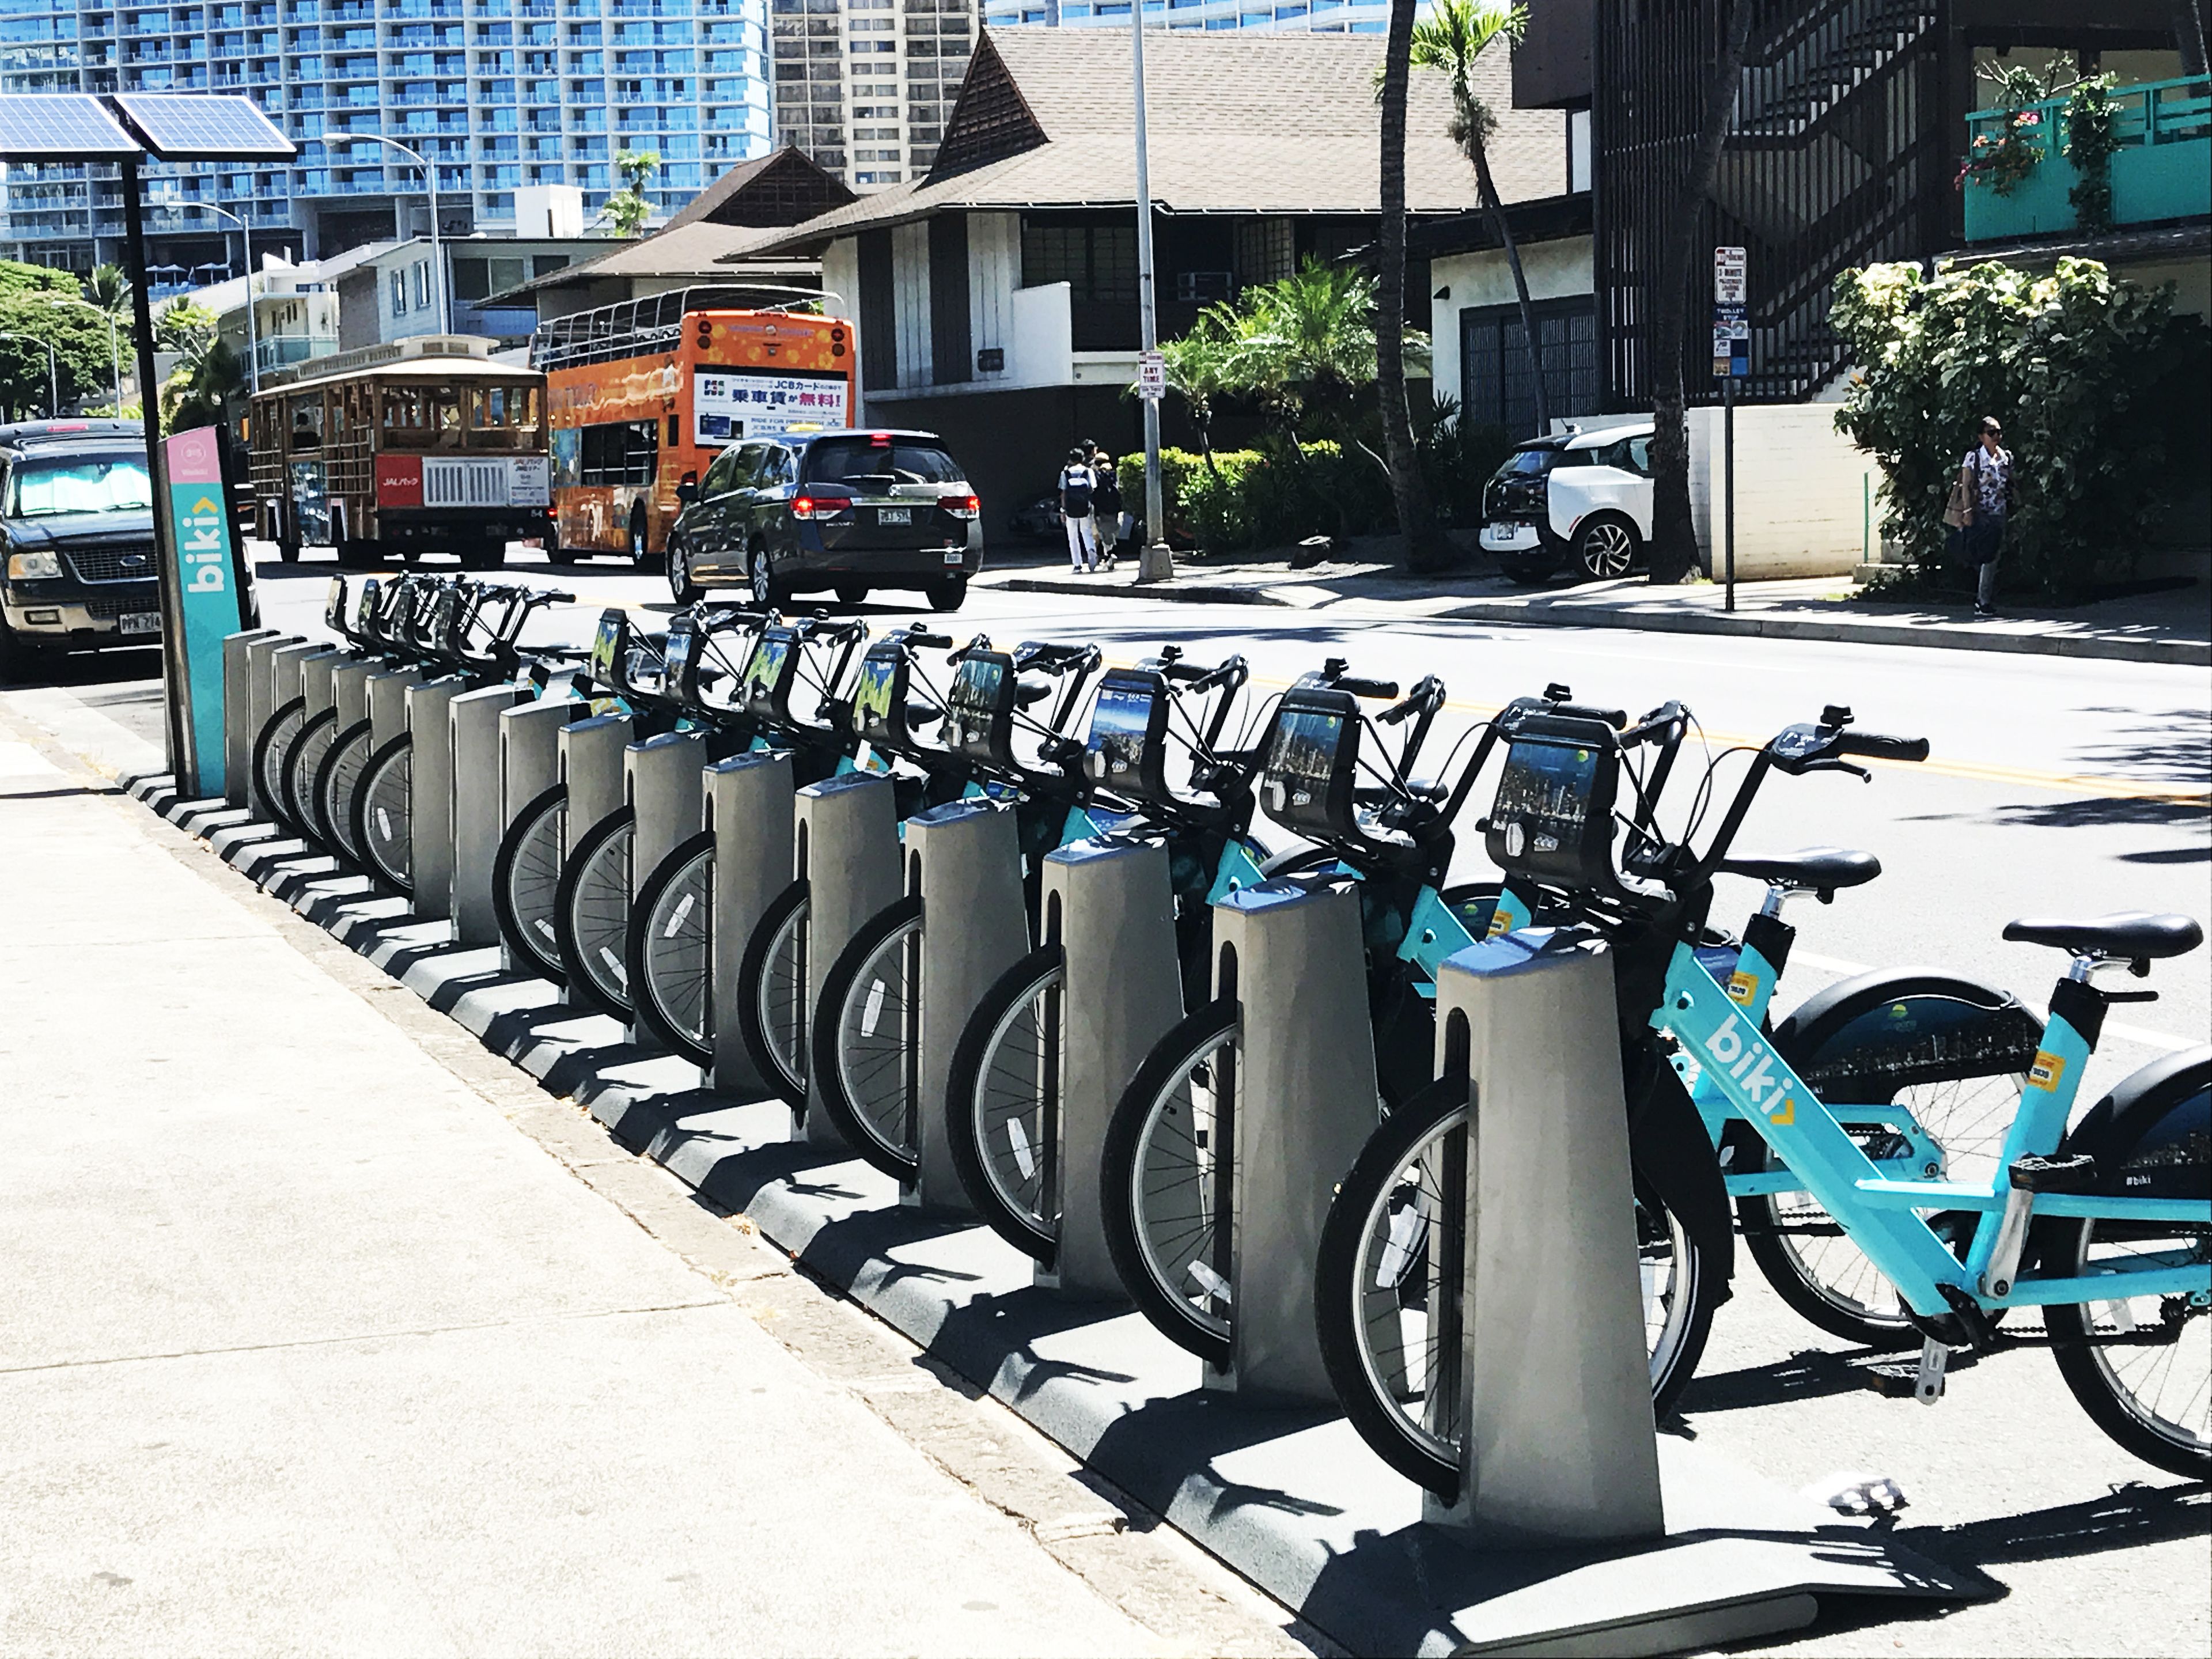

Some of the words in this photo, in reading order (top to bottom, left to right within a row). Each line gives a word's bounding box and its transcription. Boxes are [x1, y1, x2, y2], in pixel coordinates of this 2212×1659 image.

[182, 517, 225, 593] biki
[1705, 1012, 1794, 1115] biki
[2126, 1175, 2151, 1185] #biki
